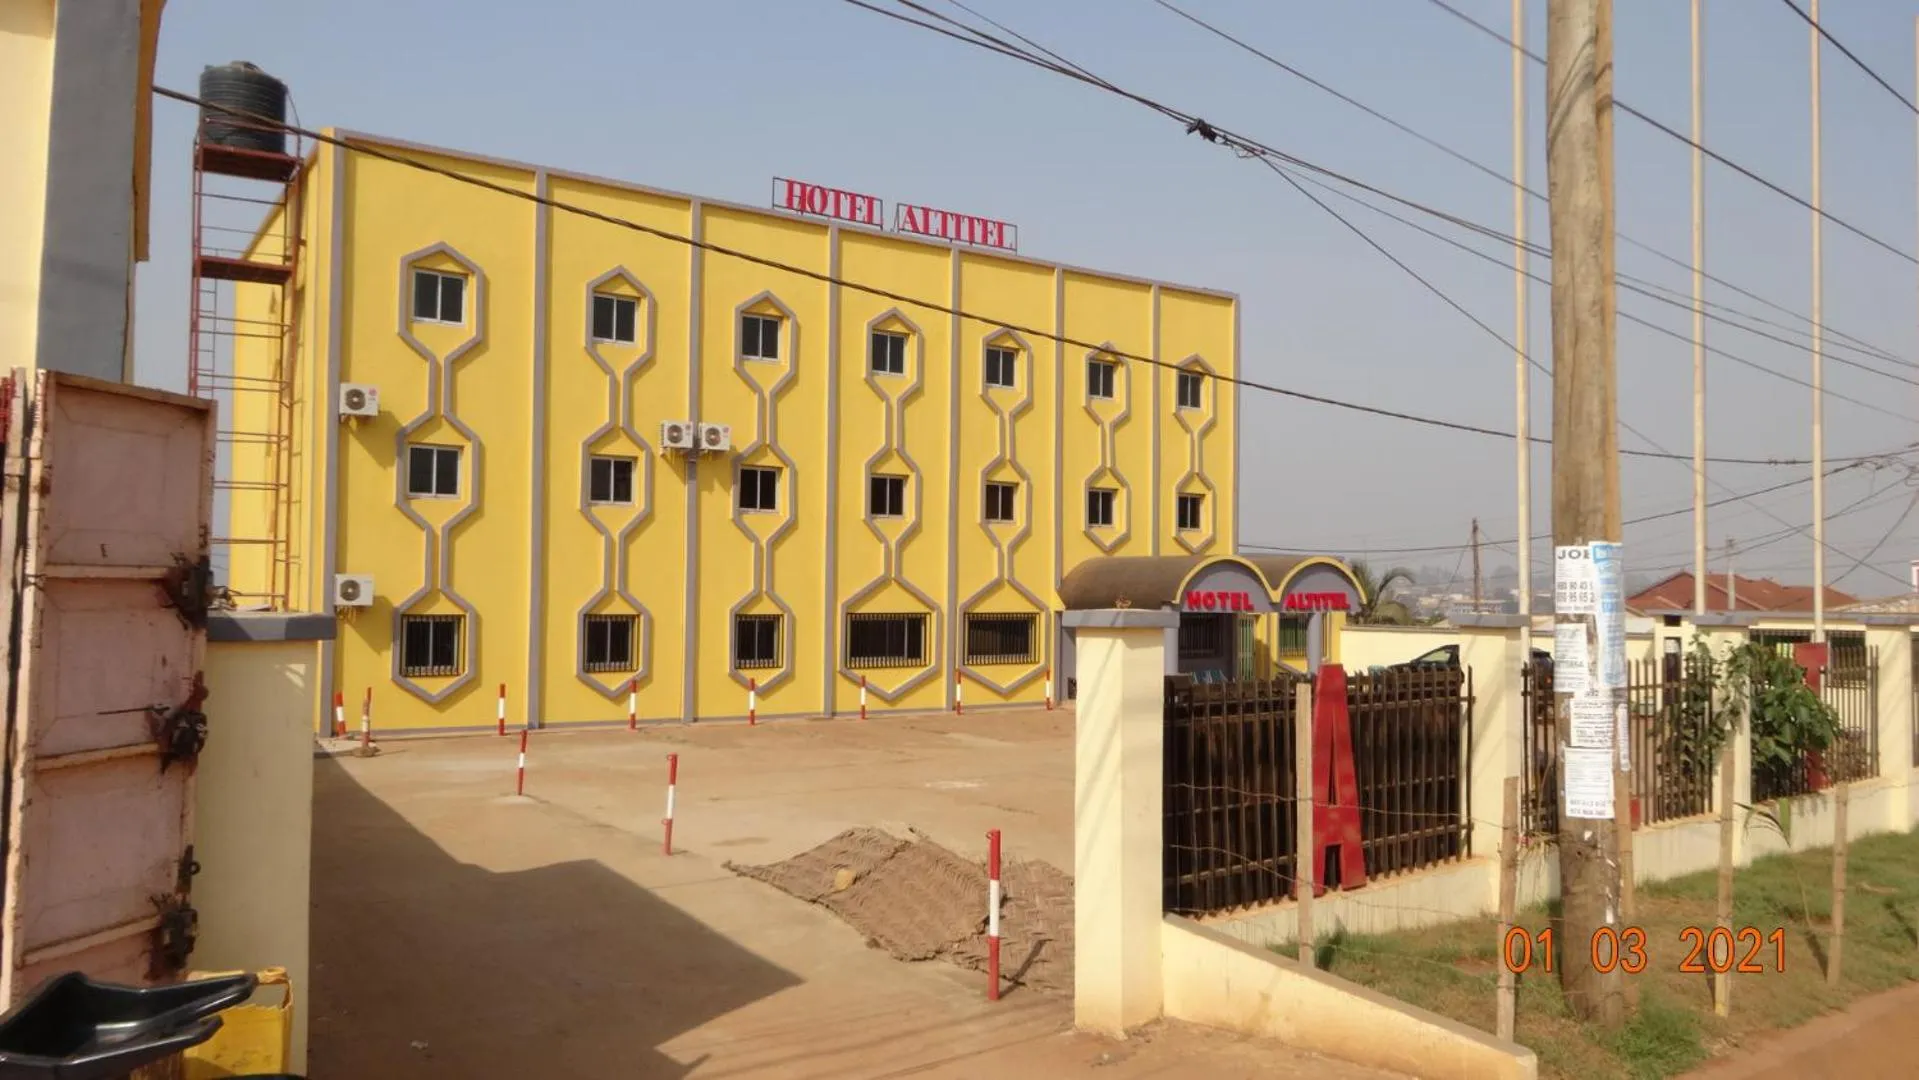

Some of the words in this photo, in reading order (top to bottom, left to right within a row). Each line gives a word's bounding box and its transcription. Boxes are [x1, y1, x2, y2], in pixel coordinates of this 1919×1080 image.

[785, 179, 881, 225] HOTEL
[900, 204, 1013, 248] ALTITEL
[1187, 591, 1254, 611] HOTEL
[1286, 592, 1350, 611] ALTITEL
